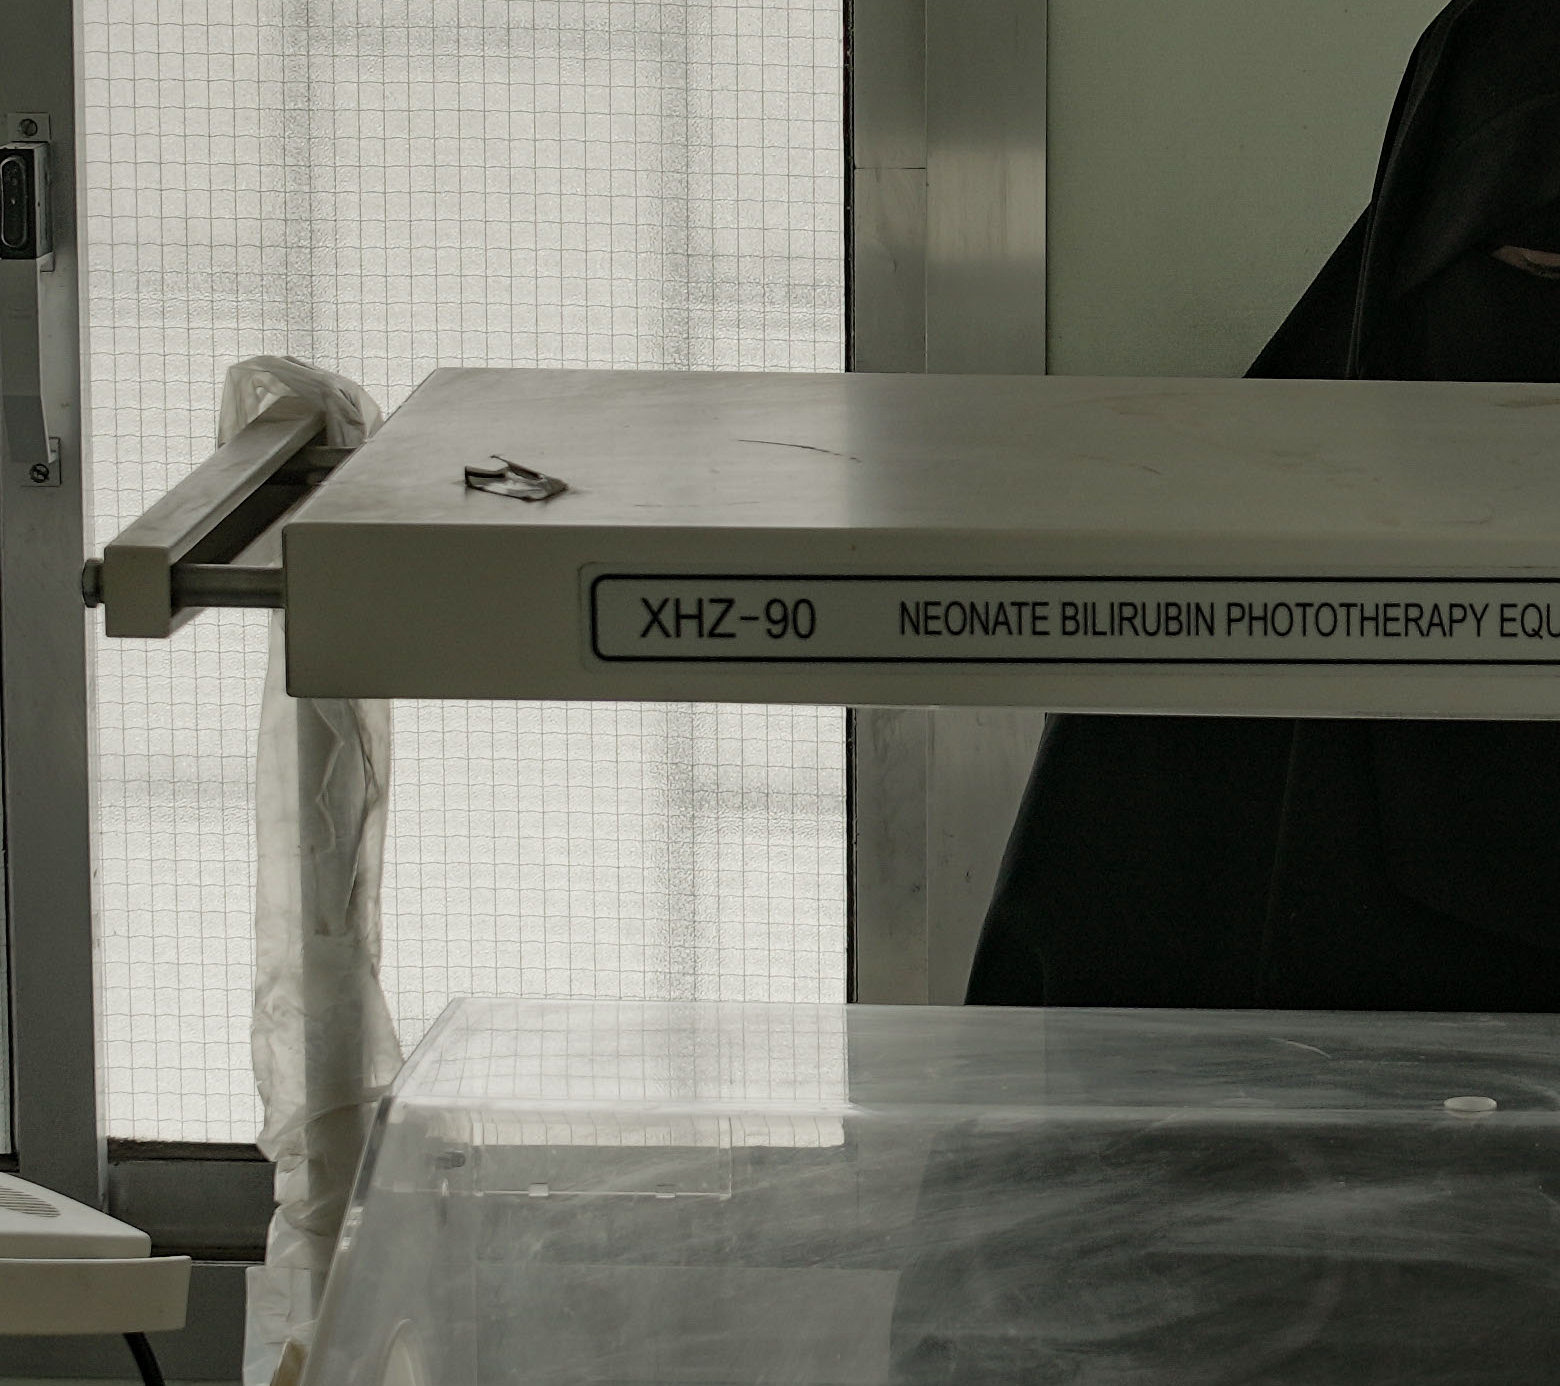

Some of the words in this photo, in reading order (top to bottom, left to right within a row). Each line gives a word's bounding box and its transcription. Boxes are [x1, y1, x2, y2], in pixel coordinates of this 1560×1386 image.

[640, 598, 816, 641] XHZ-90
[899, 600, 1051, 638] NEONATE
[1060, 600, 1215, 638] BILIRUBIN
[1226, 600, 1488, 640] PHOTOTHERAPY
